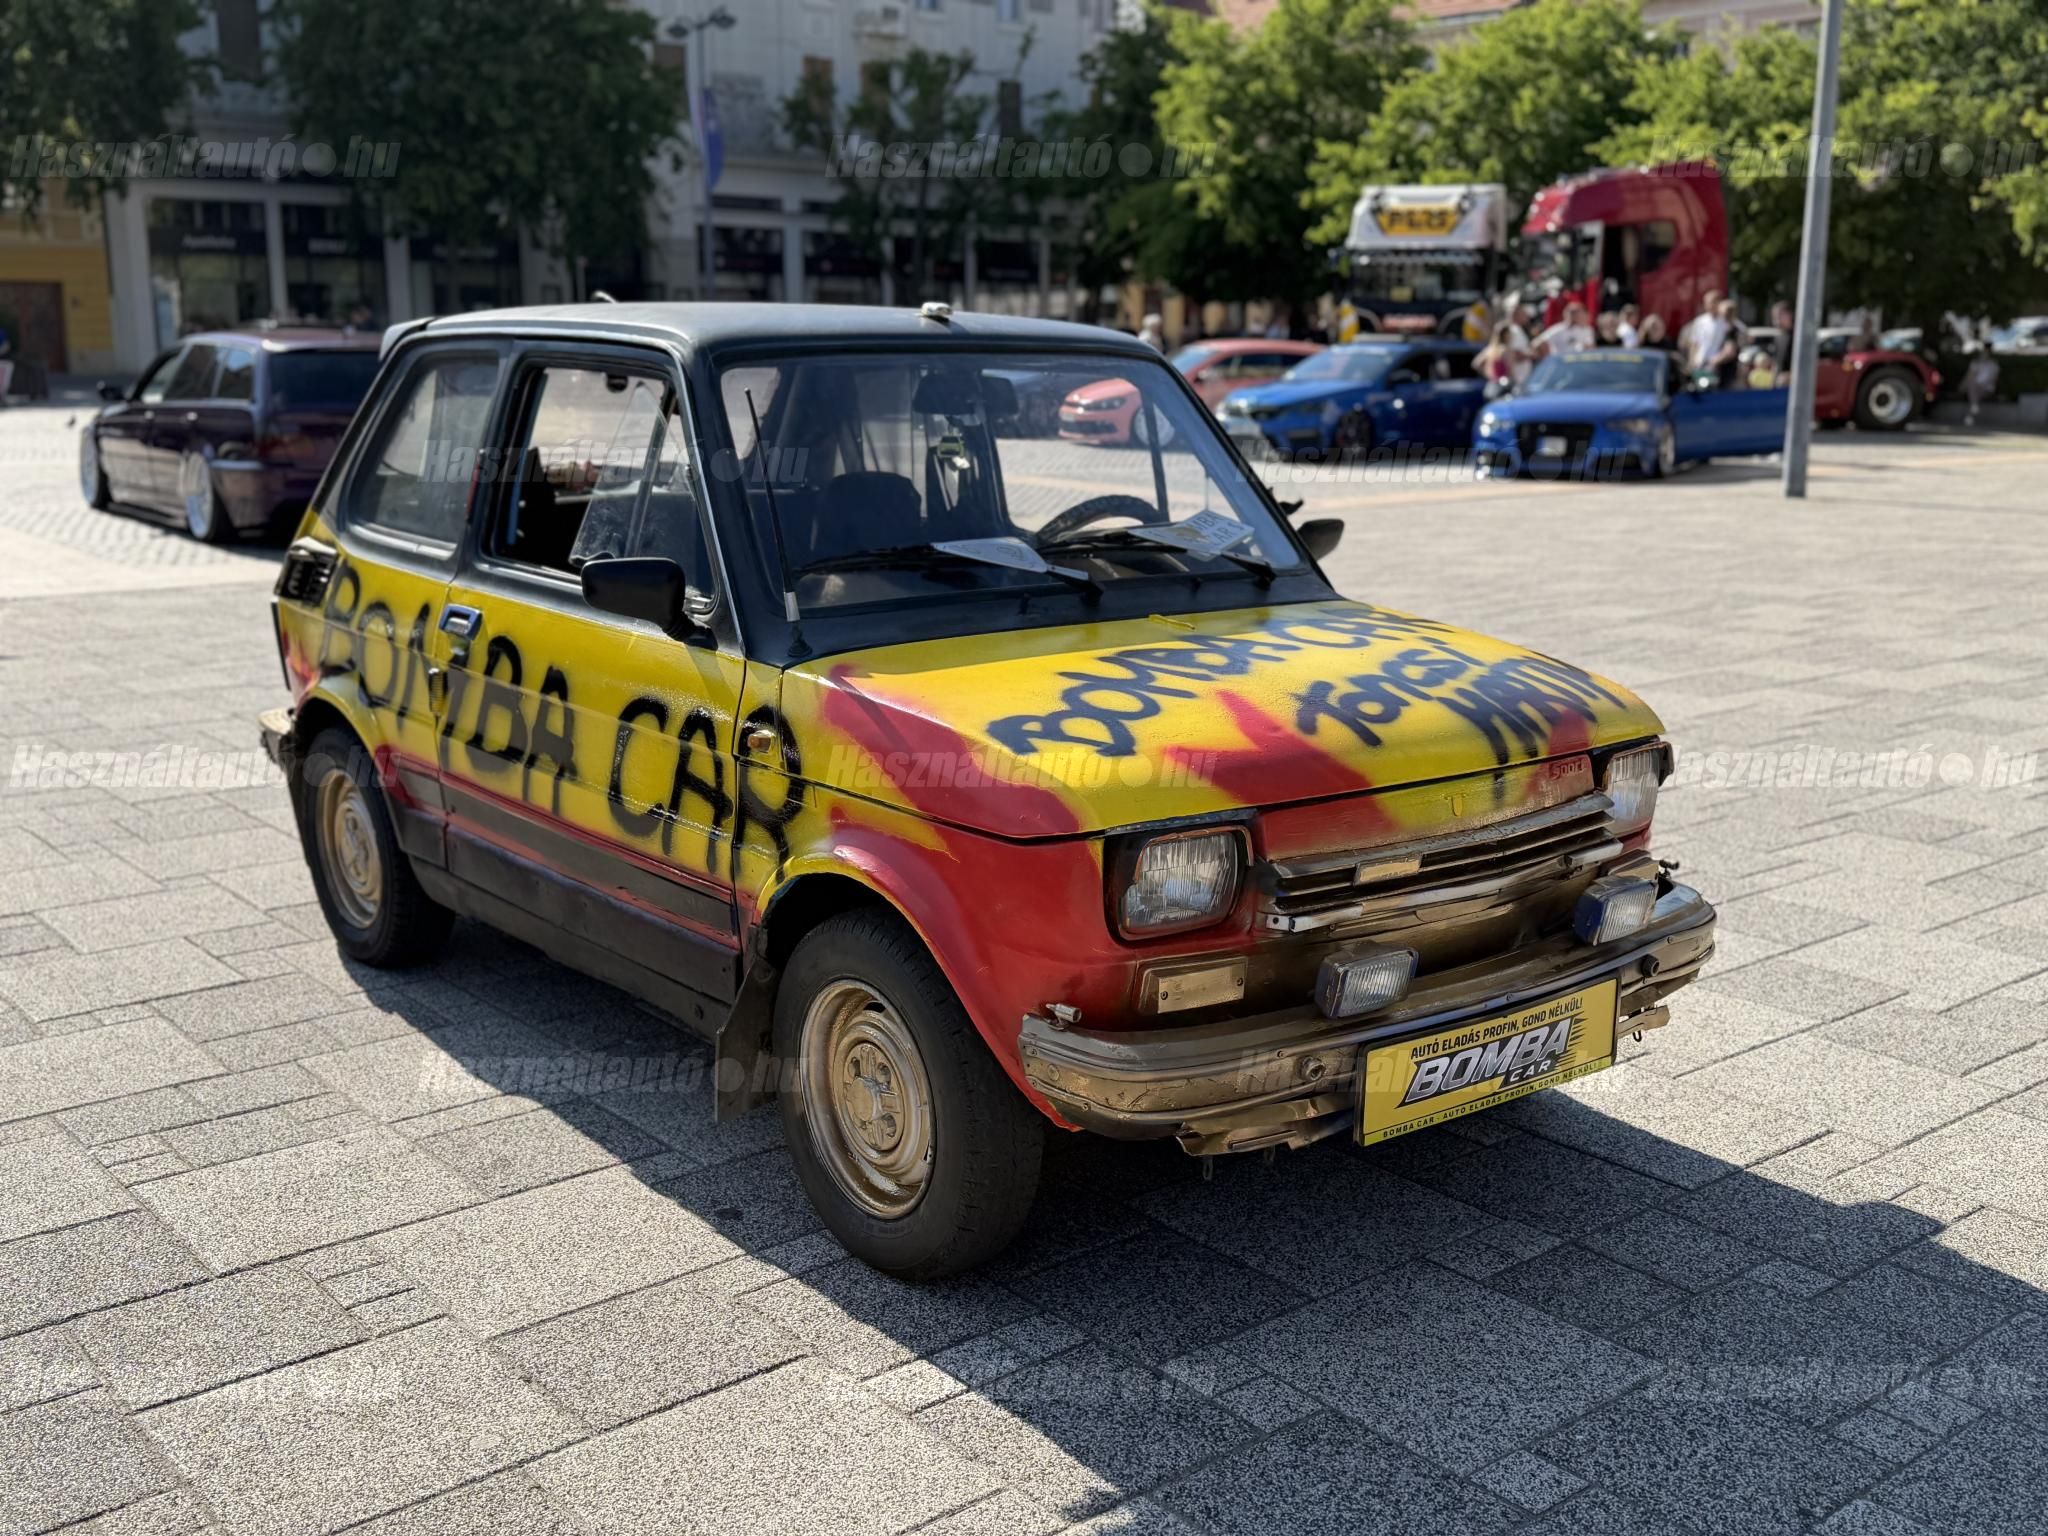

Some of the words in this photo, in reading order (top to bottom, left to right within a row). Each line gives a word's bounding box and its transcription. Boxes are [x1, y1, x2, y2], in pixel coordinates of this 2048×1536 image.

[608, 695, 806, 882] CAR
[1411, 1038, 1439, 1060] AUTÓ
[1442, 1029, 1481, 1052] ELADÁS
[1482, 1022, 1519, 1041] PROFIN,
[1522, 1010, 1546, 1029] GOND
[1404, 1017, 1572, 1104] BOMBA
[1510, 1060, 1551, 1082] CAR
[1383, 1123, 1414, 1138] BOMBA
[1417, 1116, 1434, 1127] CAR
